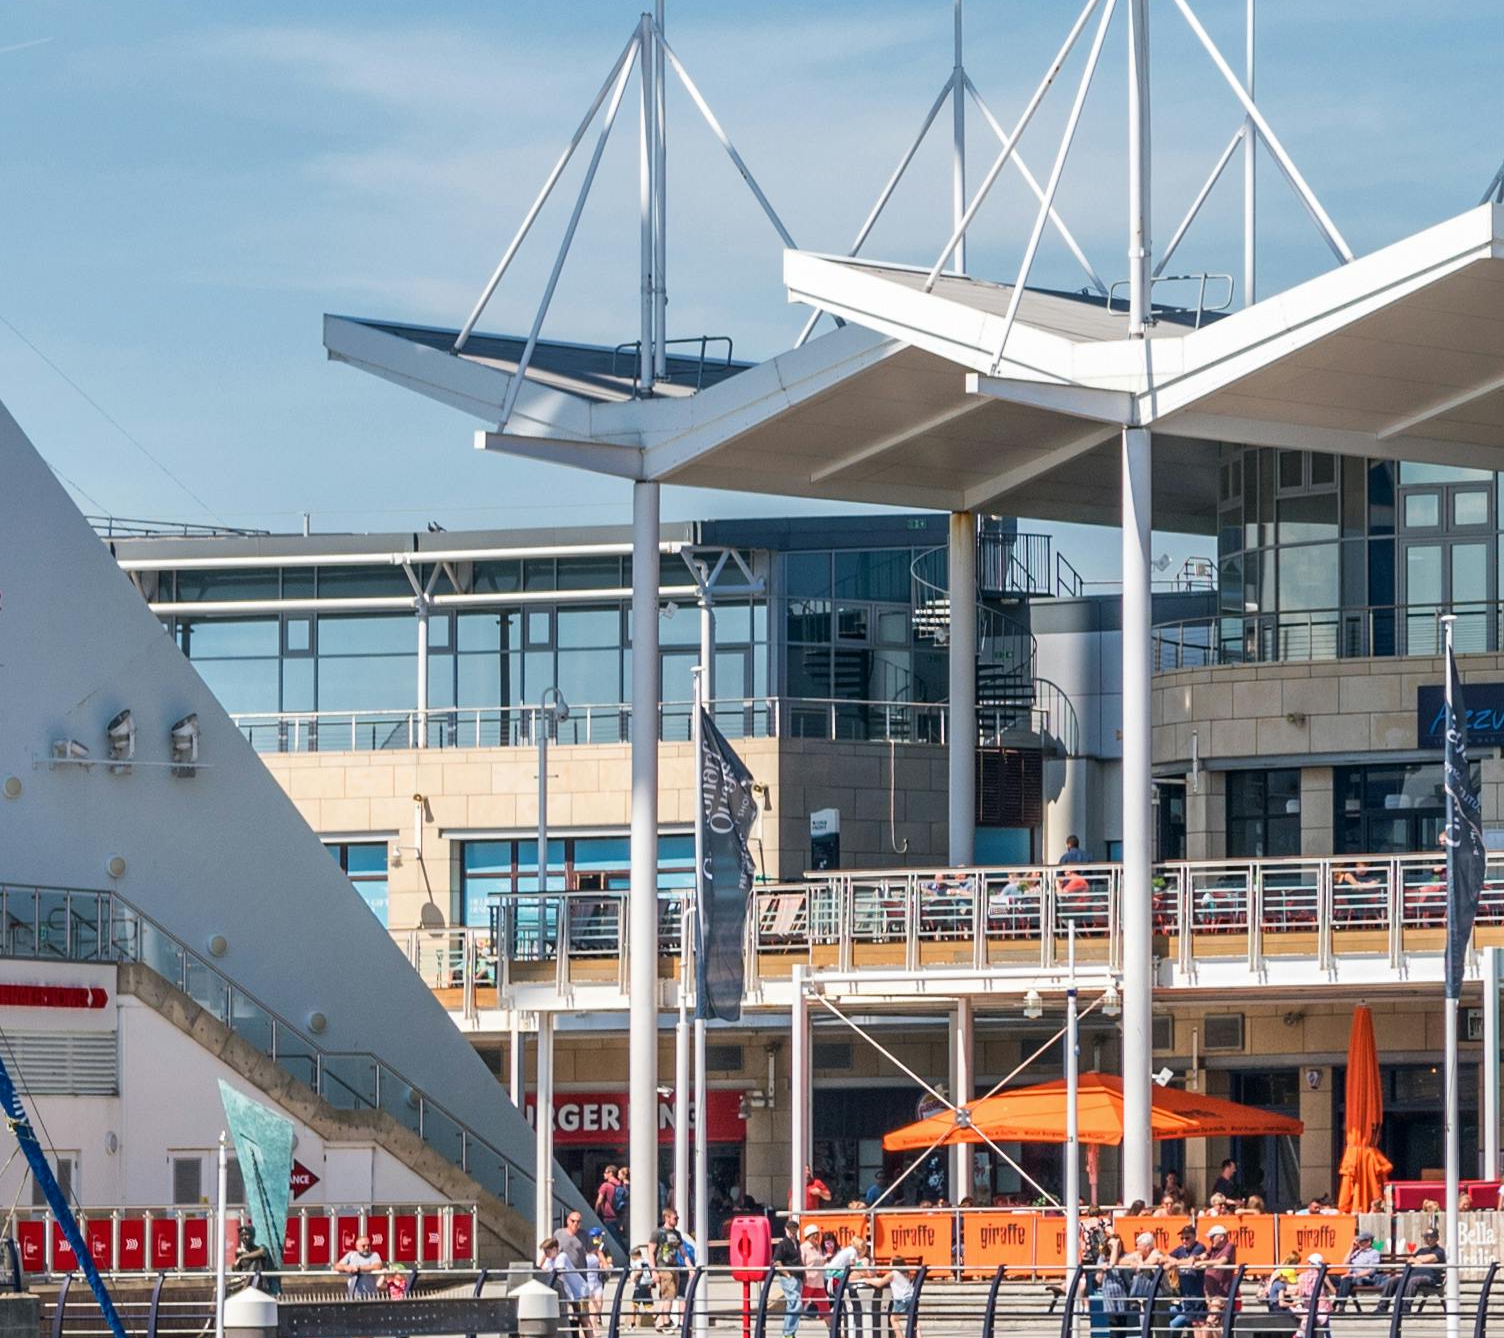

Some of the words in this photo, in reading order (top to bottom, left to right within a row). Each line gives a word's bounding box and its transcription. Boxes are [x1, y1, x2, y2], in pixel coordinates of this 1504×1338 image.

[891, 1224, 934, 1250] giraffe
[979, 1221, 1021, 1249] giraffe
[1296, 1225, 1336, 1254] giraffe
[1457, 1220, 1496, 1246] Bella
